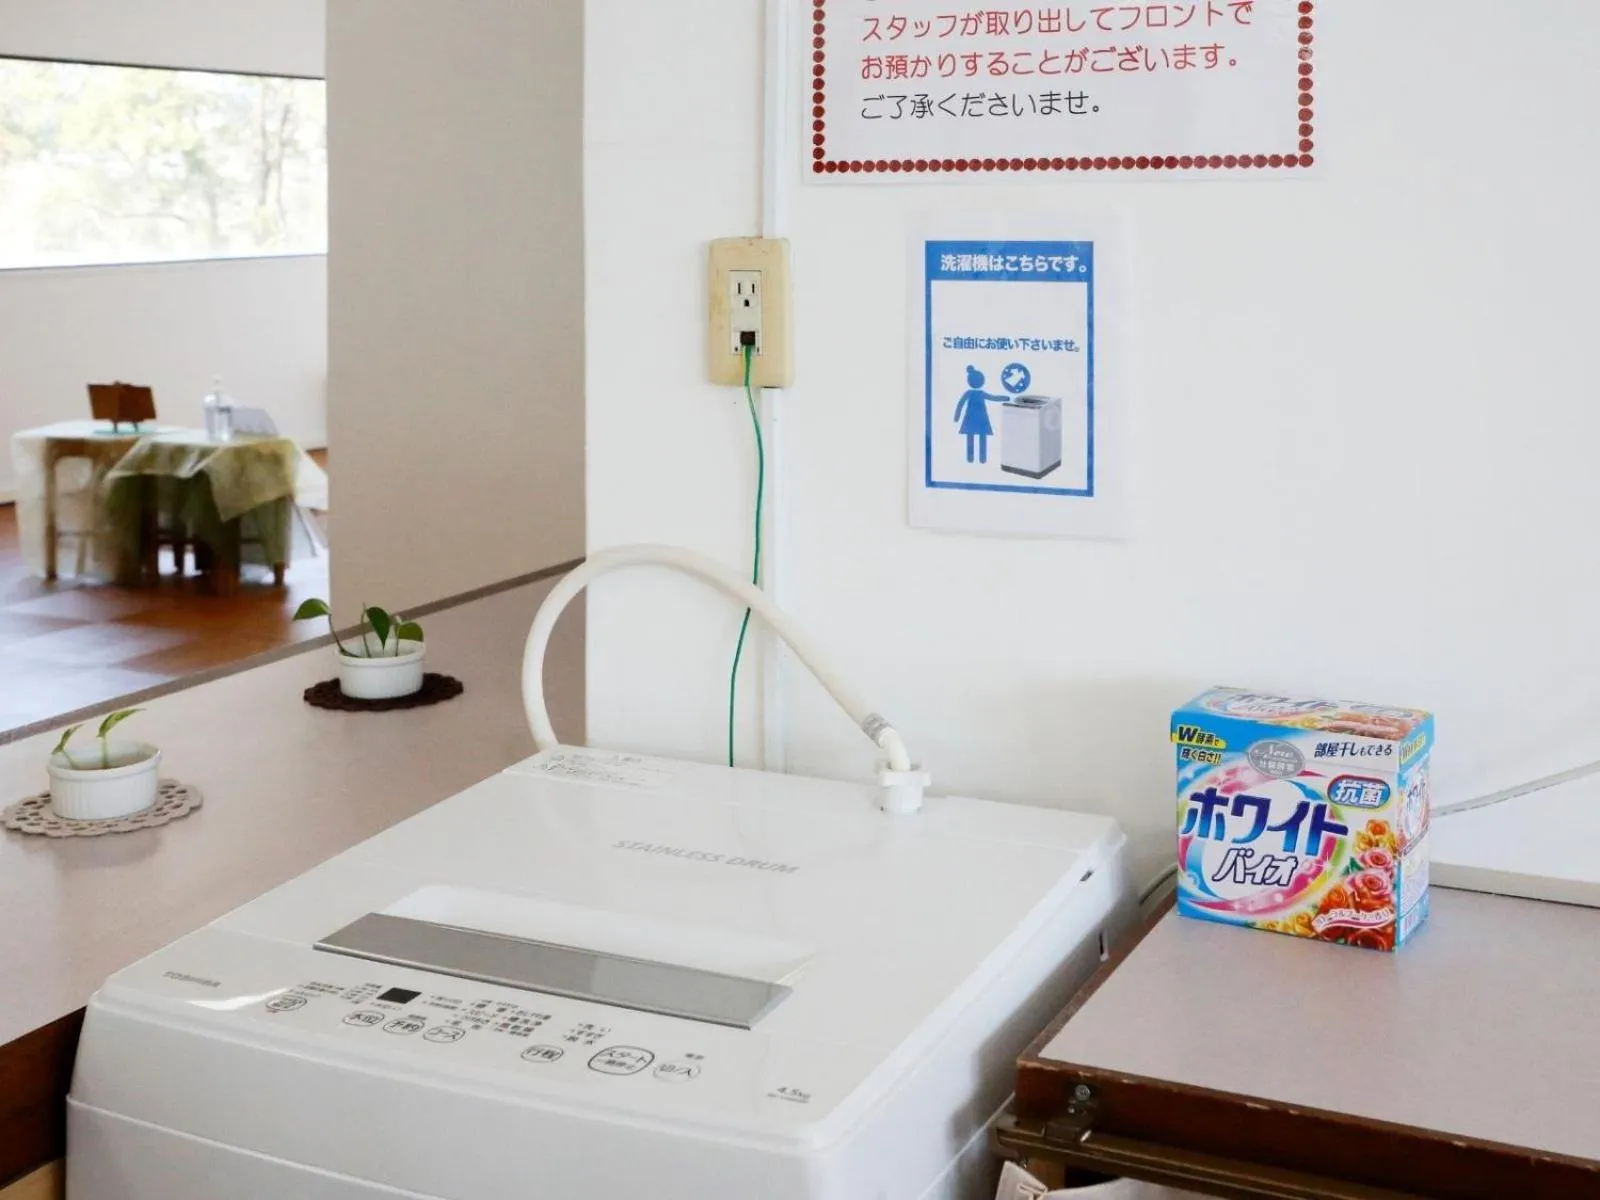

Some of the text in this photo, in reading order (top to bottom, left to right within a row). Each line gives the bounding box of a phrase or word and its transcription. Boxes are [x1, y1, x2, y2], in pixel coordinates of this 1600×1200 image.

[862, 1, 1253, 42] スタッフが取り出してフロントで
[861, 43, 1238, 80] お預かりすることがございます。
[861, 90, 1100, 120] ご了承くださいませ。
[940, 253, 1088, 274] 洗濯機はこちらです。
[942, 336, 1080, 353] ご自由にお使い下さいませ。
[1314, 741, 1393, 758] 部屋干しもできる
[1334, 779, 1386, 806] 抗菌
[1181, 786, 1349, 857] ホワイト
[612, 840, 800, 874] STAINLESS DRUM
[1212, 847, 1299, 887] バイオ
